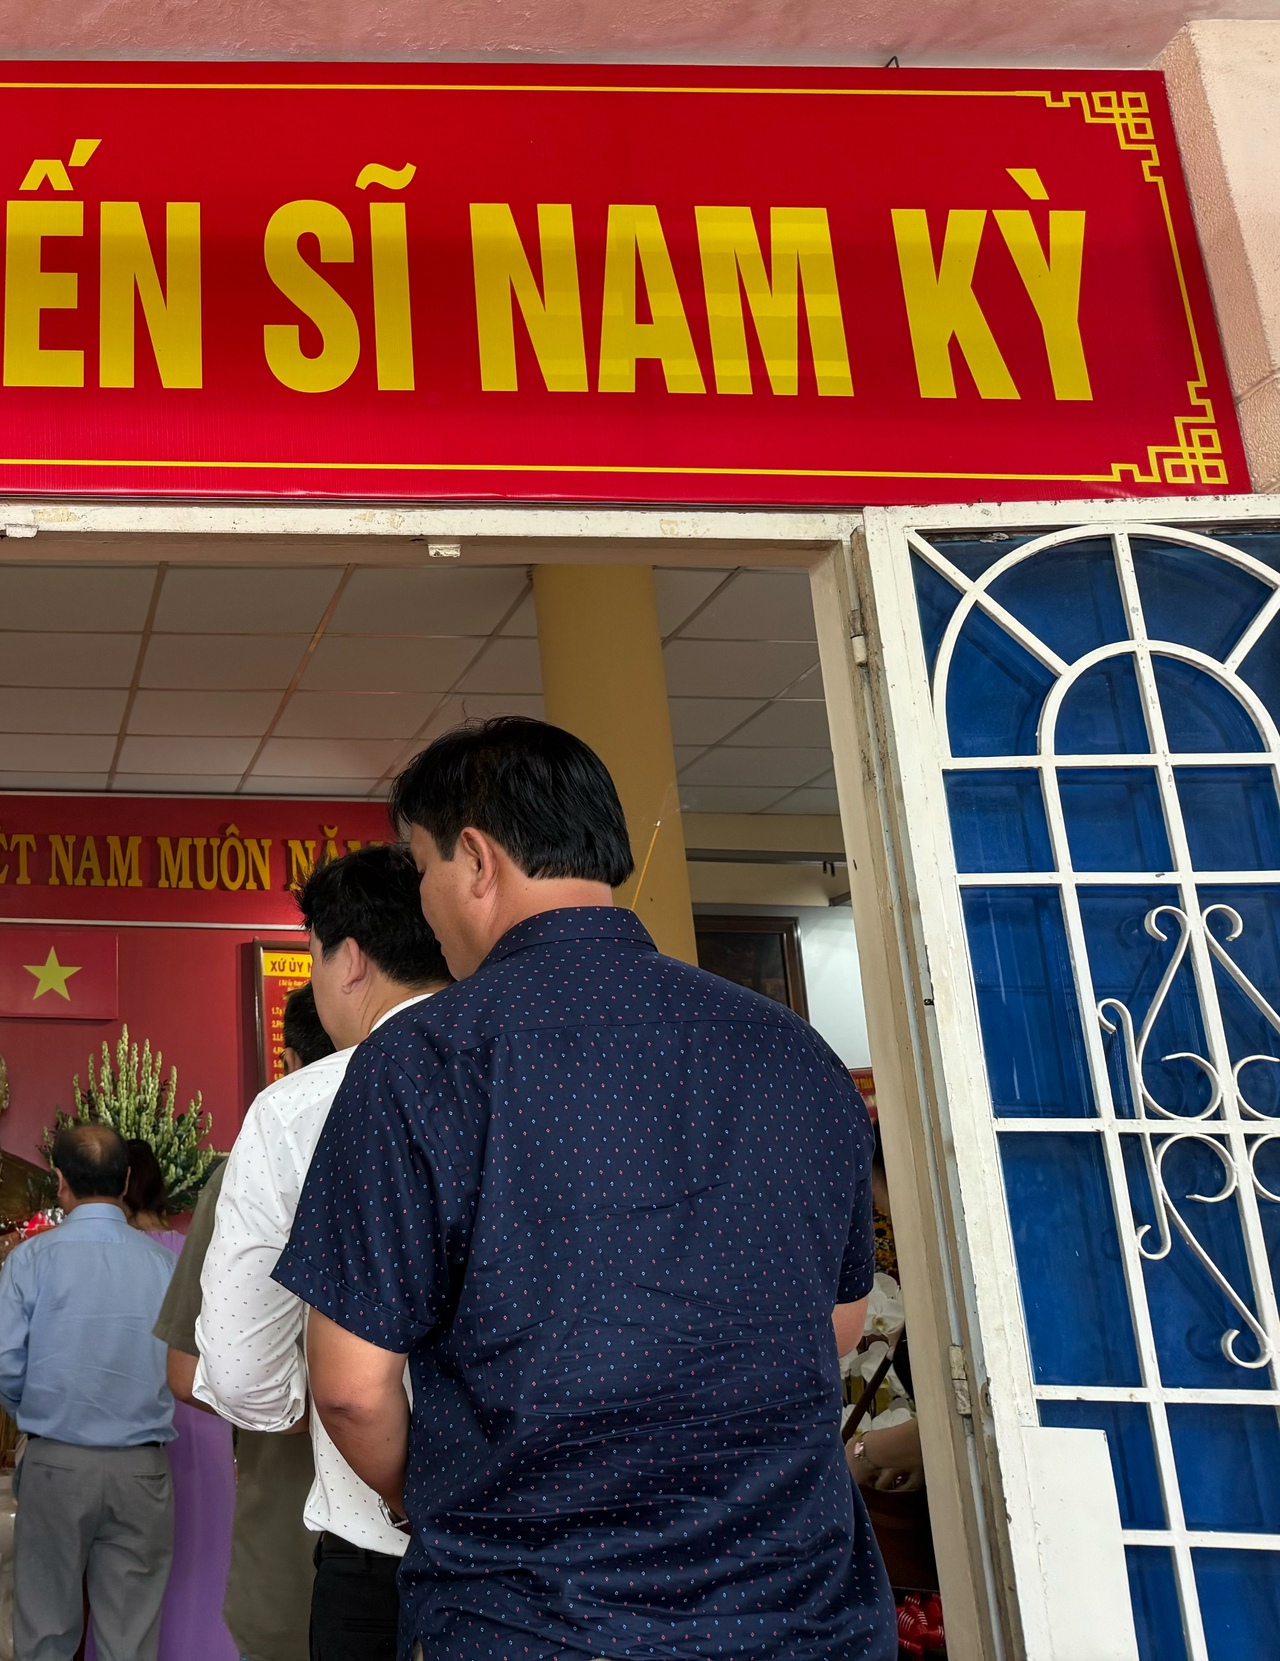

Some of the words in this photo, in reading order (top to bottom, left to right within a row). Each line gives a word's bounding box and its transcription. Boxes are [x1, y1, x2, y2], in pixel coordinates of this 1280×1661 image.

[264, 163, 416, 393] SĨ
[470, 203, 854, 397] NAM
[891, 168, 1092, 400] KỲ
[49, 835, 142, 887] NAM
[157, 824, 272, 891] MUÔN
[288, 825, 384, 891] NĂ
